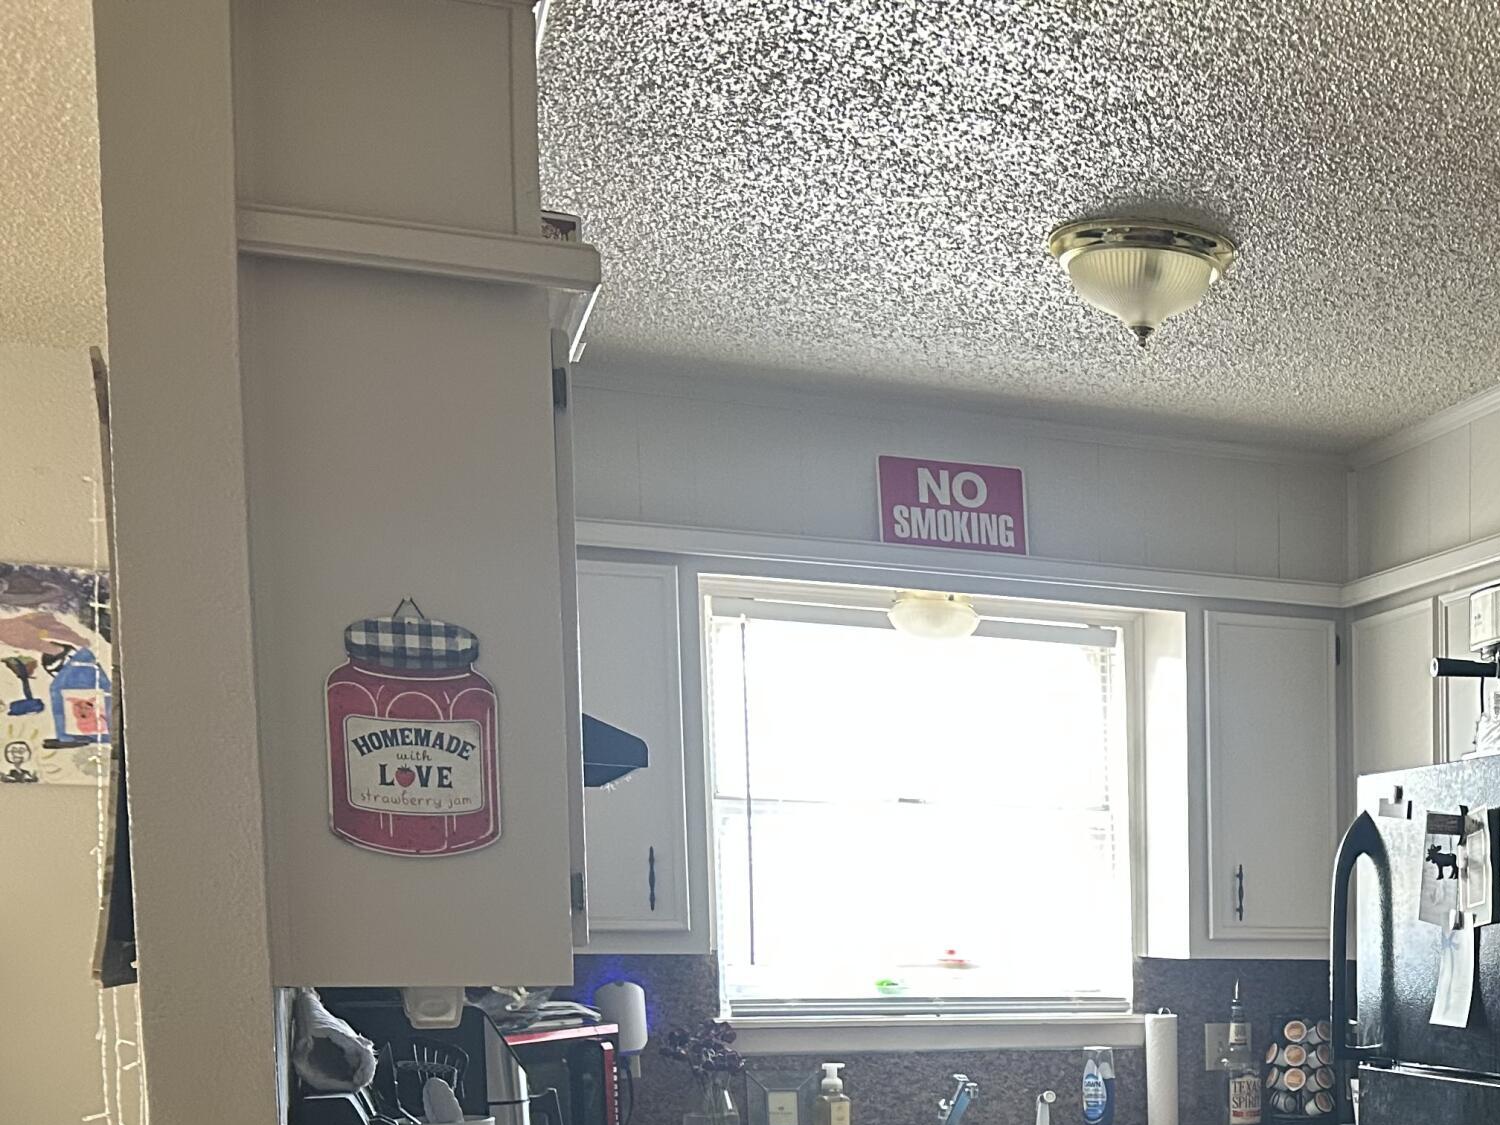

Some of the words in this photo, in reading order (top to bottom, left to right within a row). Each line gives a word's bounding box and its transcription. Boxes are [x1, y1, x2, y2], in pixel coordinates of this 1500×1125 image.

[917, 467, 988, 509] NO
[893, 504, 1015, 548] SMOKING
[351, 727, 477, 761] HOMEMADE
[396, 749, 433, 762] with
[361, 786, 443, 809] strawberry
[448, 791, 473, 809] jam
